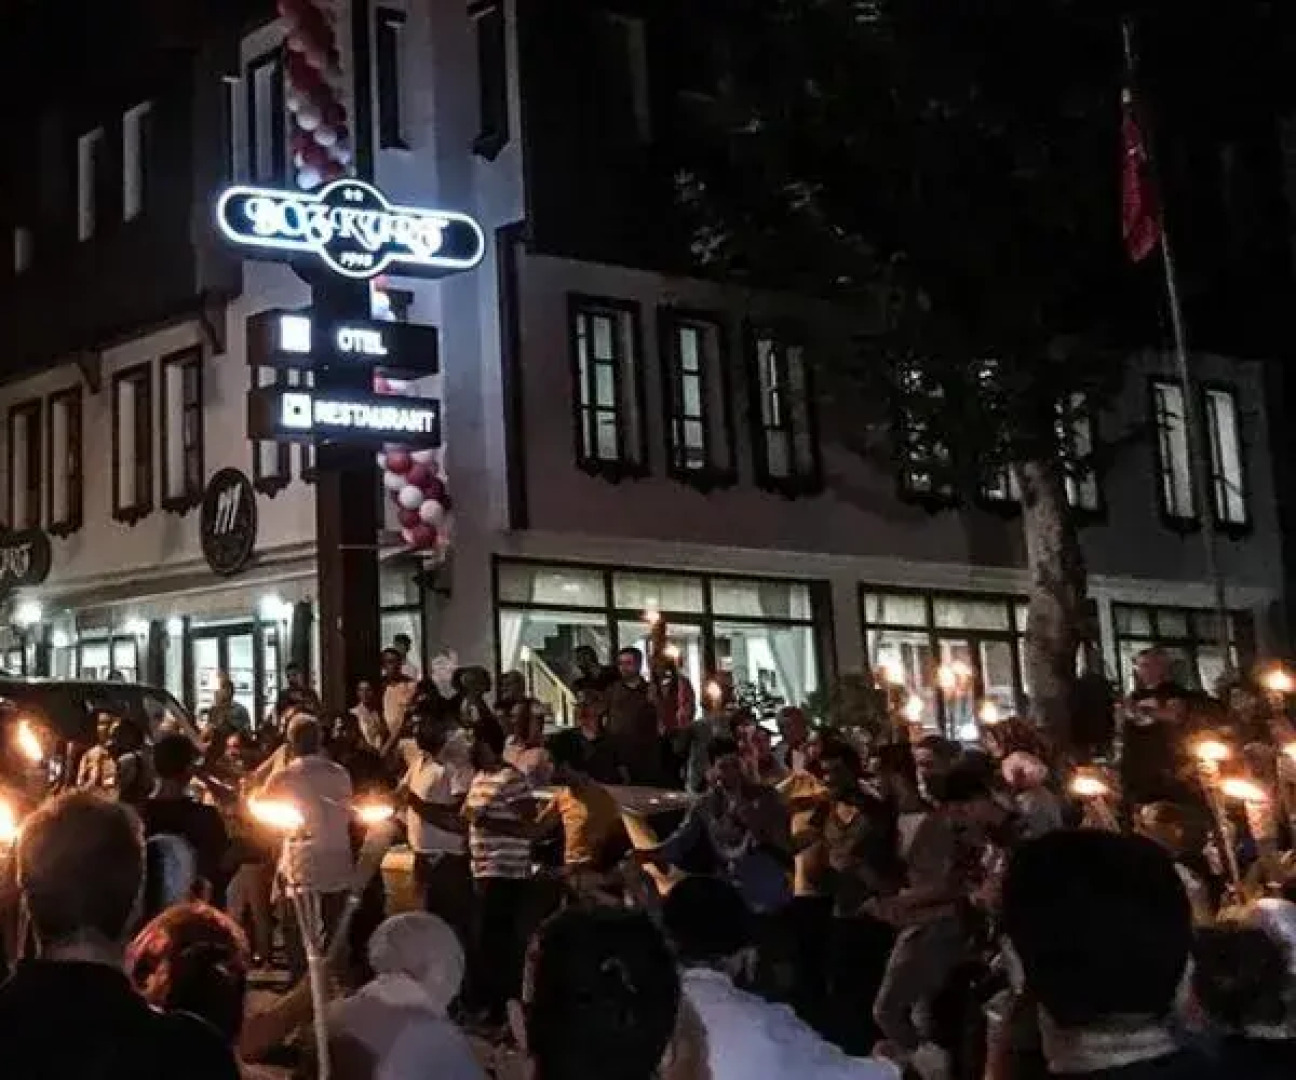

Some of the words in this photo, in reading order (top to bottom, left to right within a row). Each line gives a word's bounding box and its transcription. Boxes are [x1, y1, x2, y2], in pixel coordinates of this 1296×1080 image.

[244, 198, 450, 256] BOZKURT
[337, 327, 388, 355] OTEL
[314, 401, 434, 433] RESTAURANT
